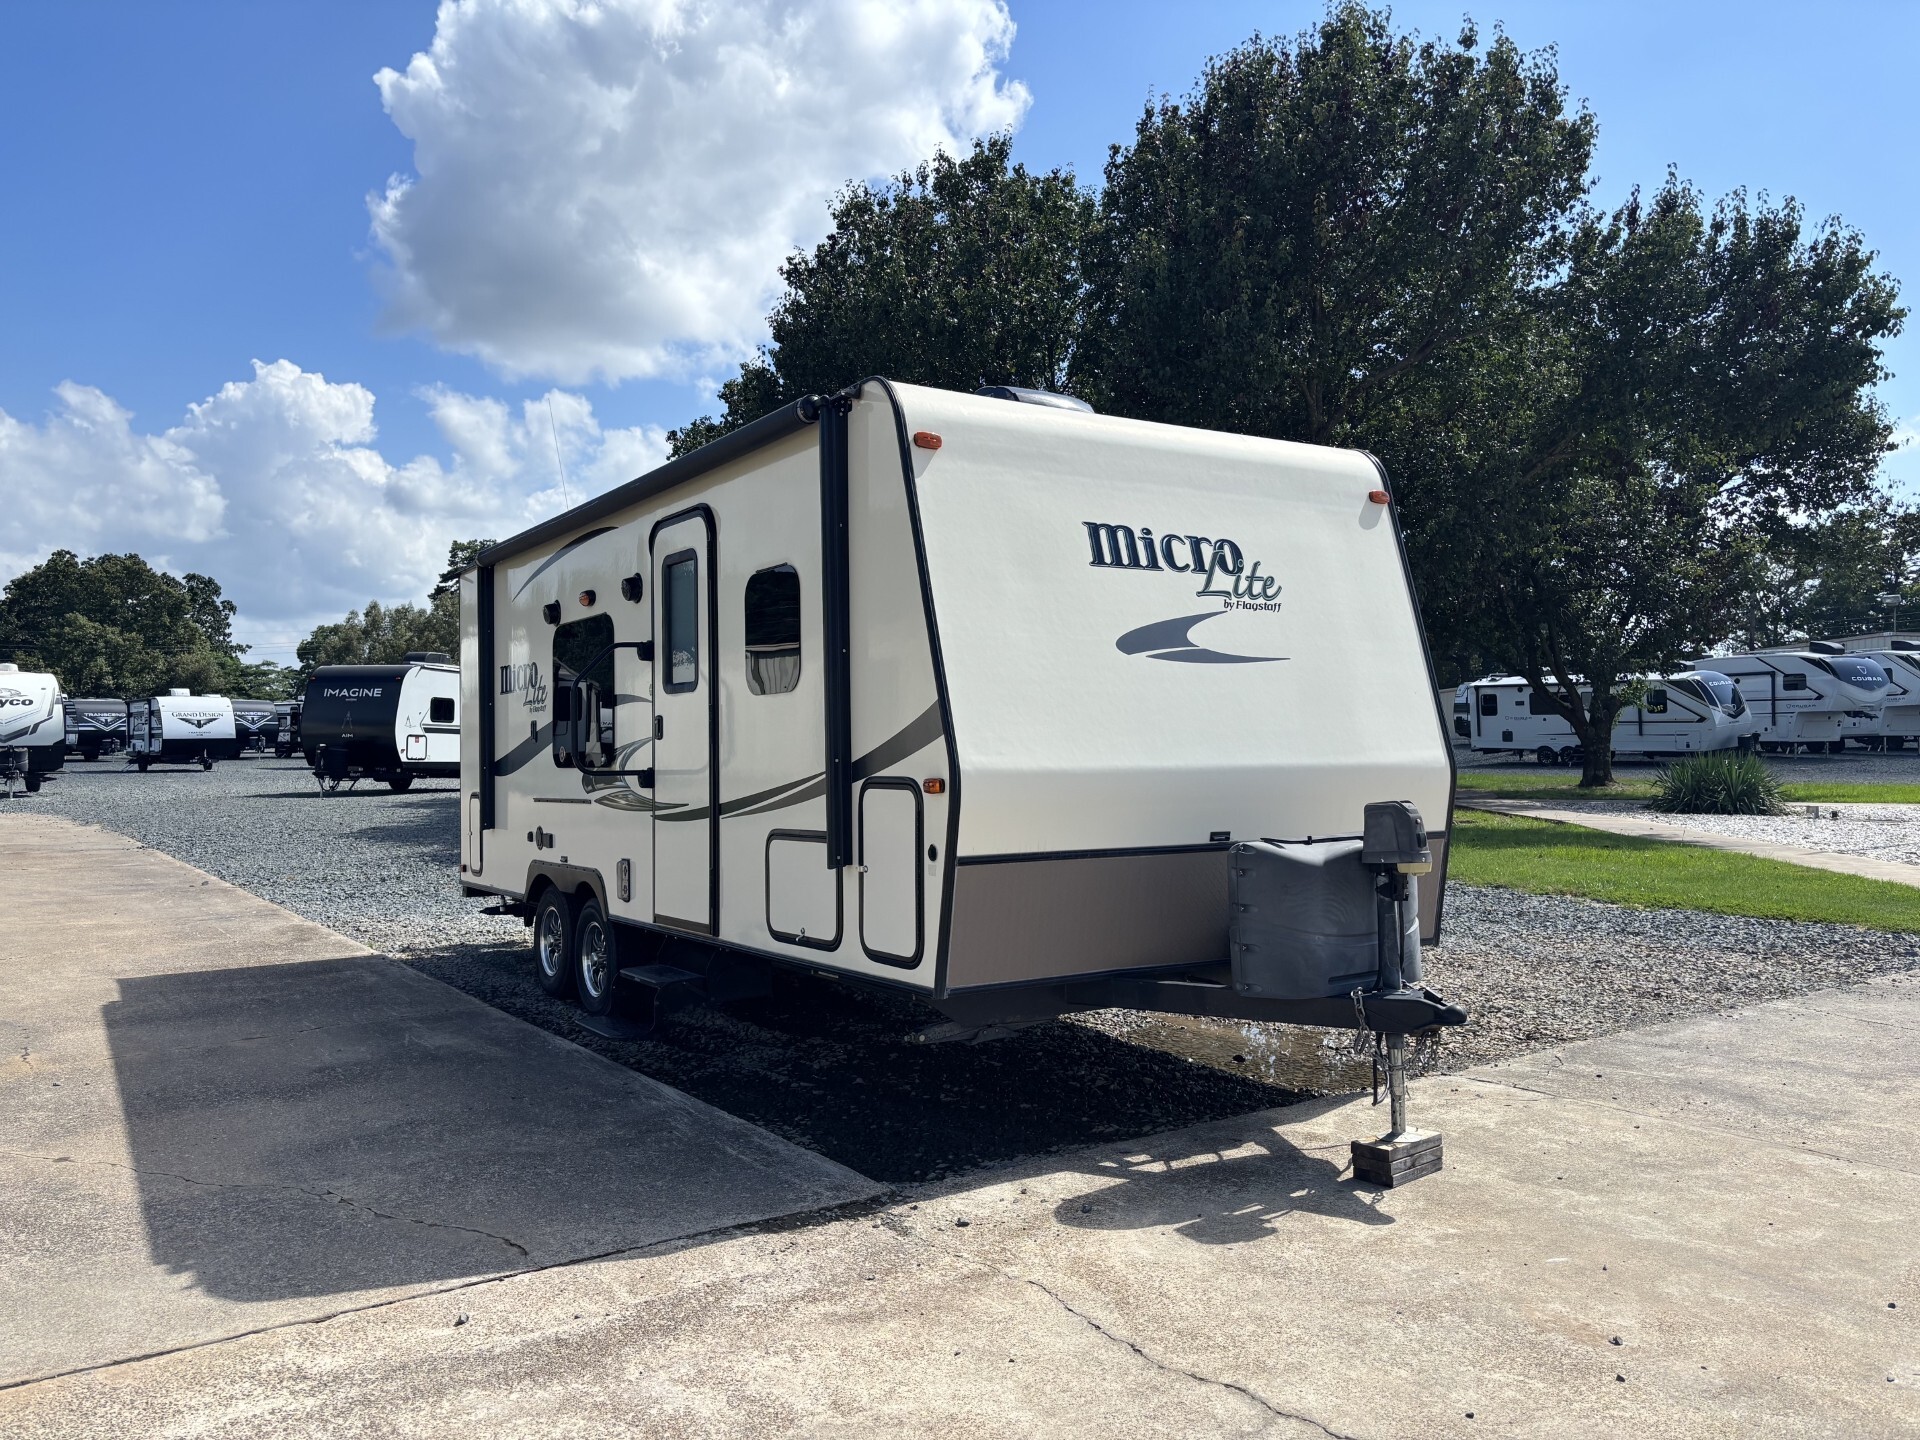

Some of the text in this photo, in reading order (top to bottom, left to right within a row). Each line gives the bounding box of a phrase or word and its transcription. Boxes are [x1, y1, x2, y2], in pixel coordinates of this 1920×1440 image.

[1196, 550, 1282, 601] Lite
[1223, 599, 1282, 613] by Flagstaff
[323, 688, 383, 697] IMAGINE
[523, 671, 548, 707] Lite
